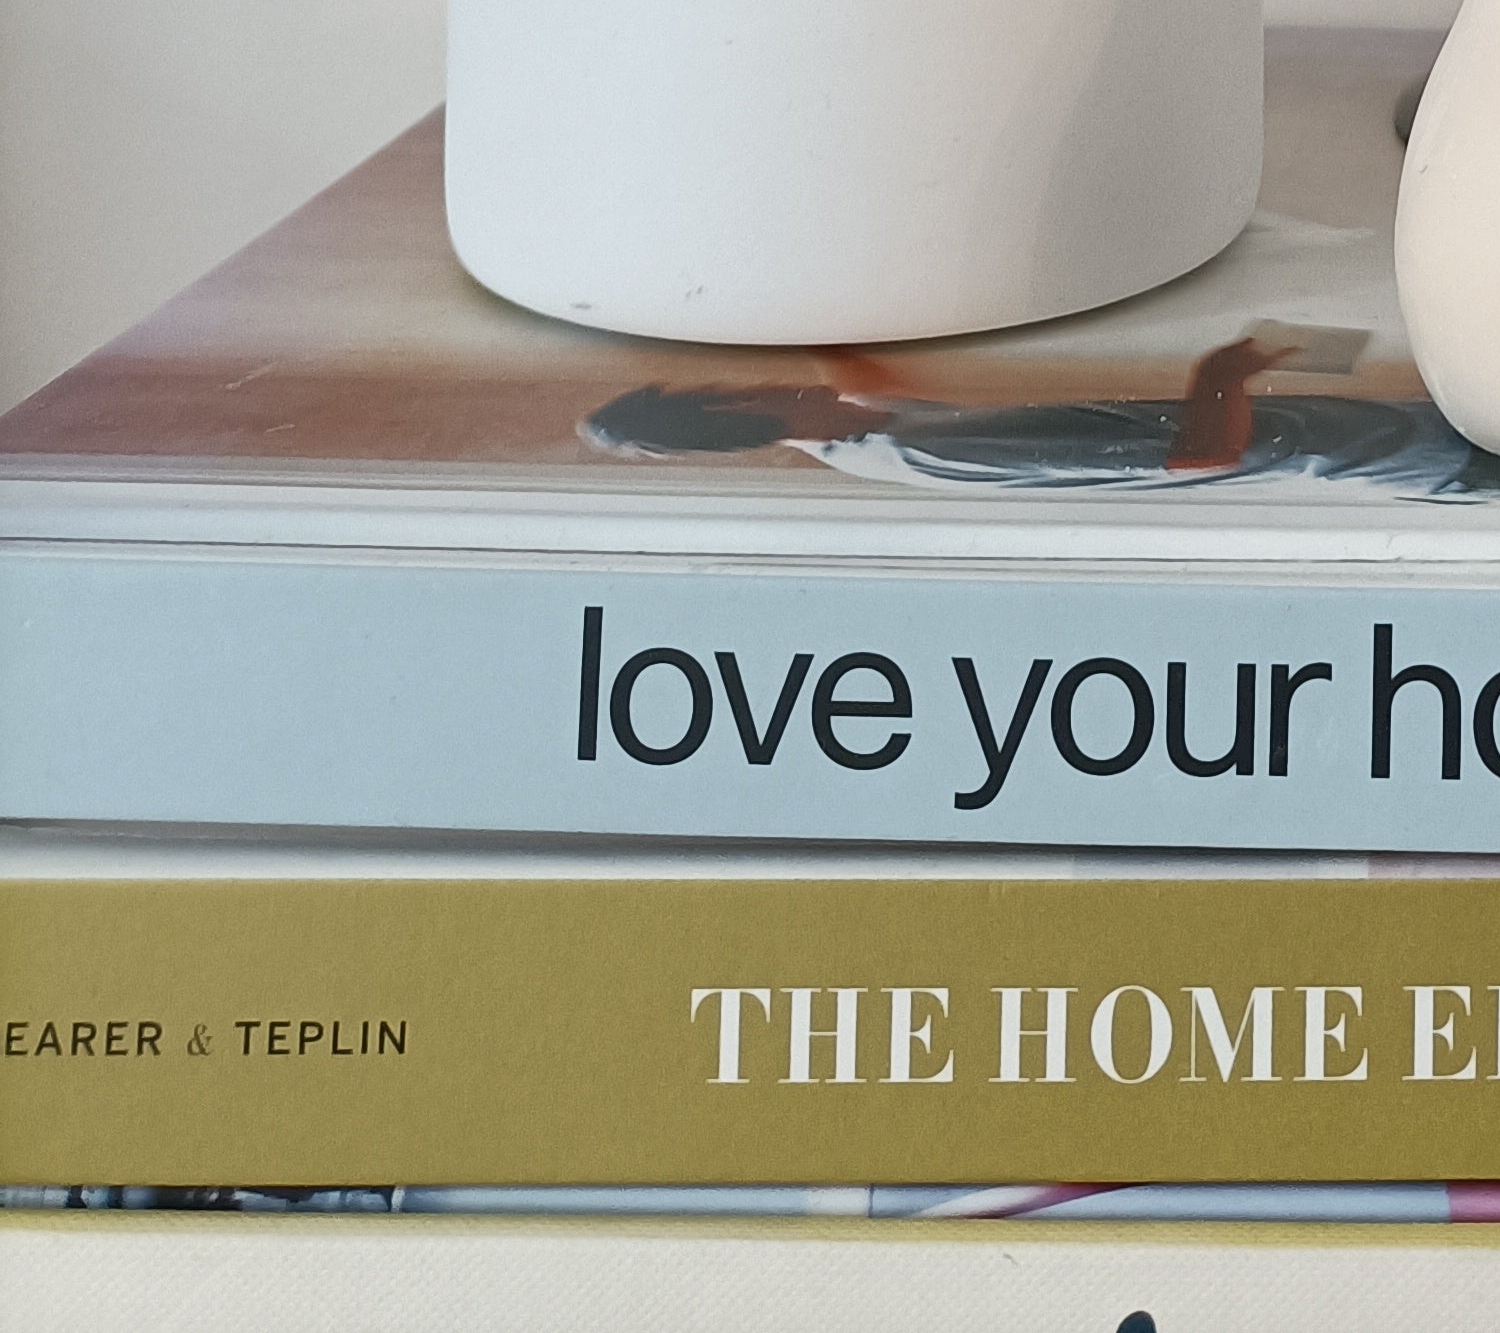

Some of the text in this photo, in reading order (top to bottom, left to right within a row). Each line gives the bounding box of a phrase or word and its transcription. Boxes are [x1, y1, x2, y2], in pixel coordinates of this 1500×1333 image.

[576, 605, 913, 771] love
[951, 656, 1333, 811] your
[4, 1019, 408, 1059] EARER & TEPLIN
[690, 986, 955, 1084] THE
[986, 984, 1369, 1085] HOME
